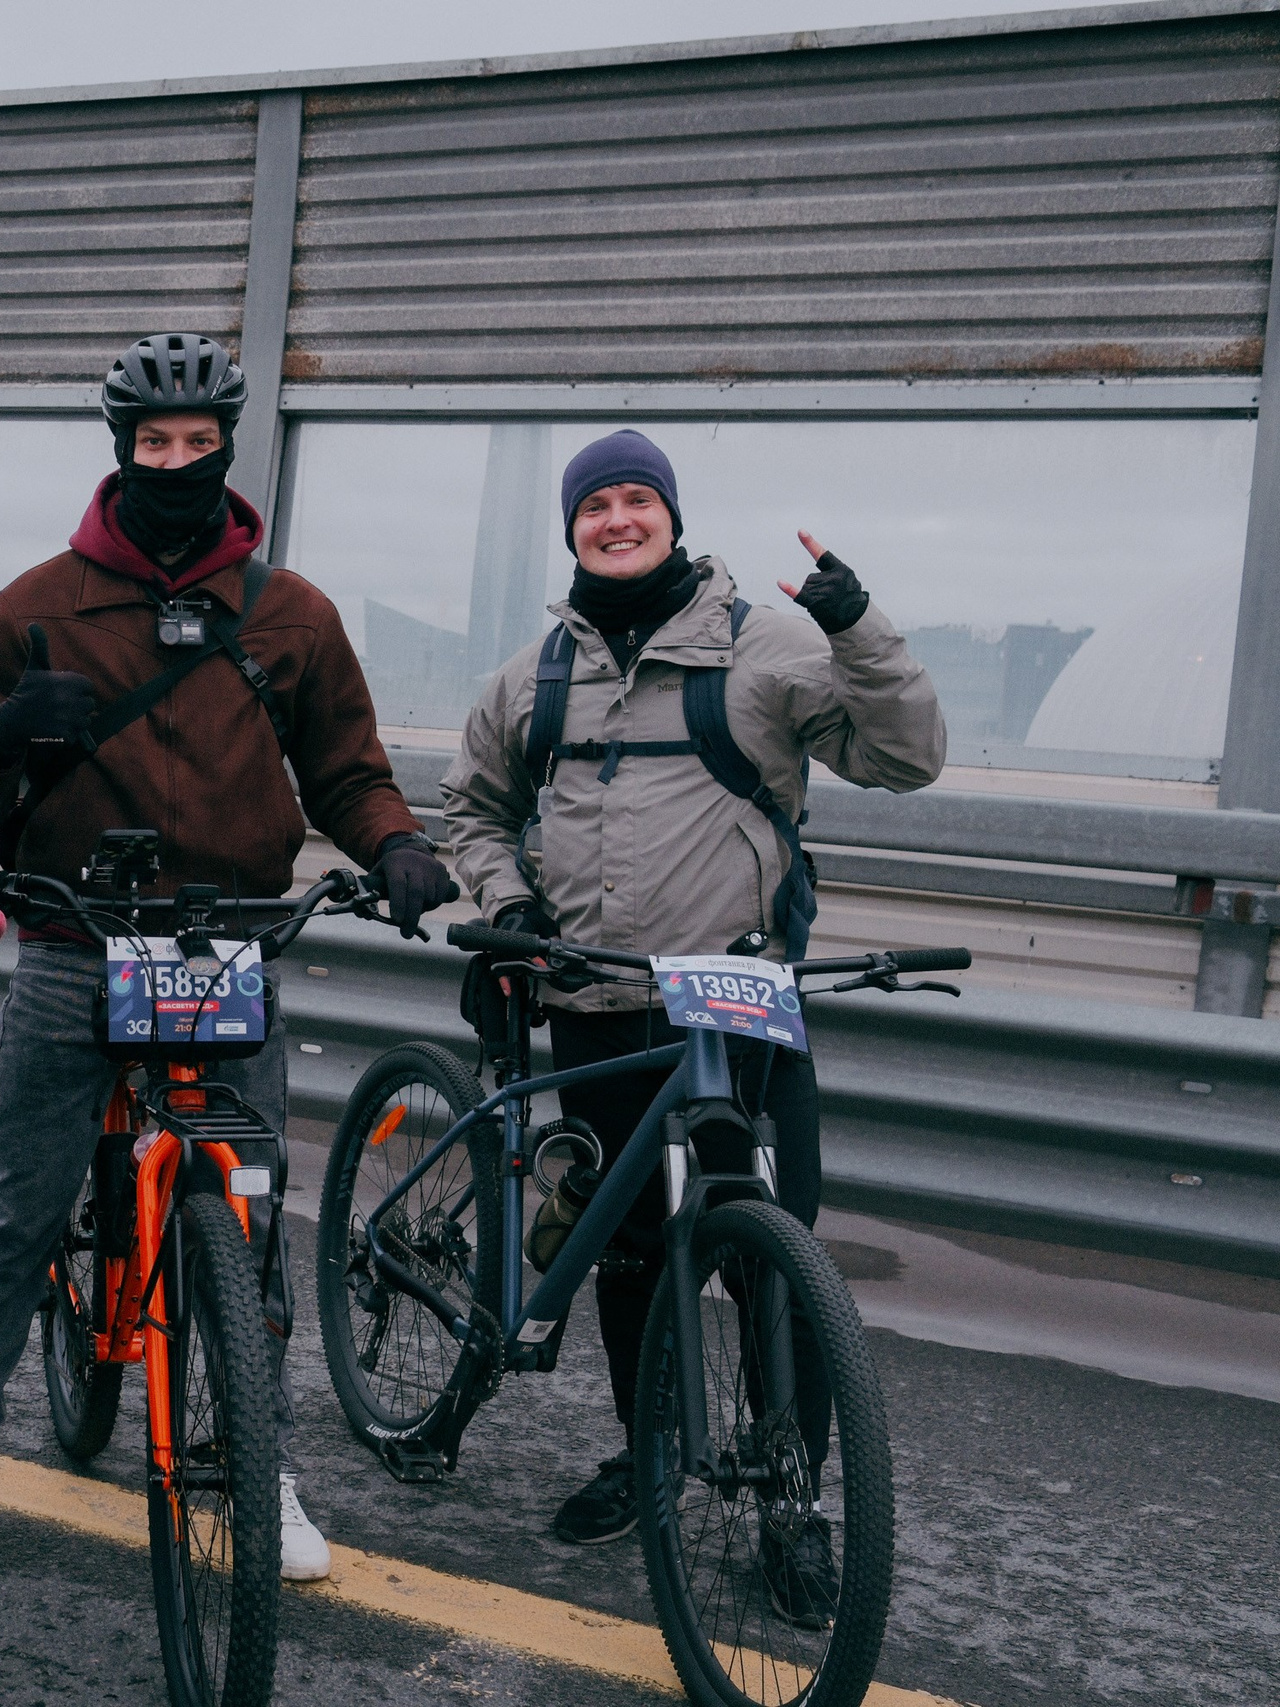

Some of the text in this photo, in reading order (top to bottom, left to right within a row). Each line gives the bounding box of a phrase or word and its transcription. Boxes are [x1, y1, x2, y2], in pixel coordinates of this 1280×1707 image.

[708, 959, 756, 971] фонтанка.ру
[687, 974, 775, 1009] 13952
[730, 1019, 752, 1030] 21:00
